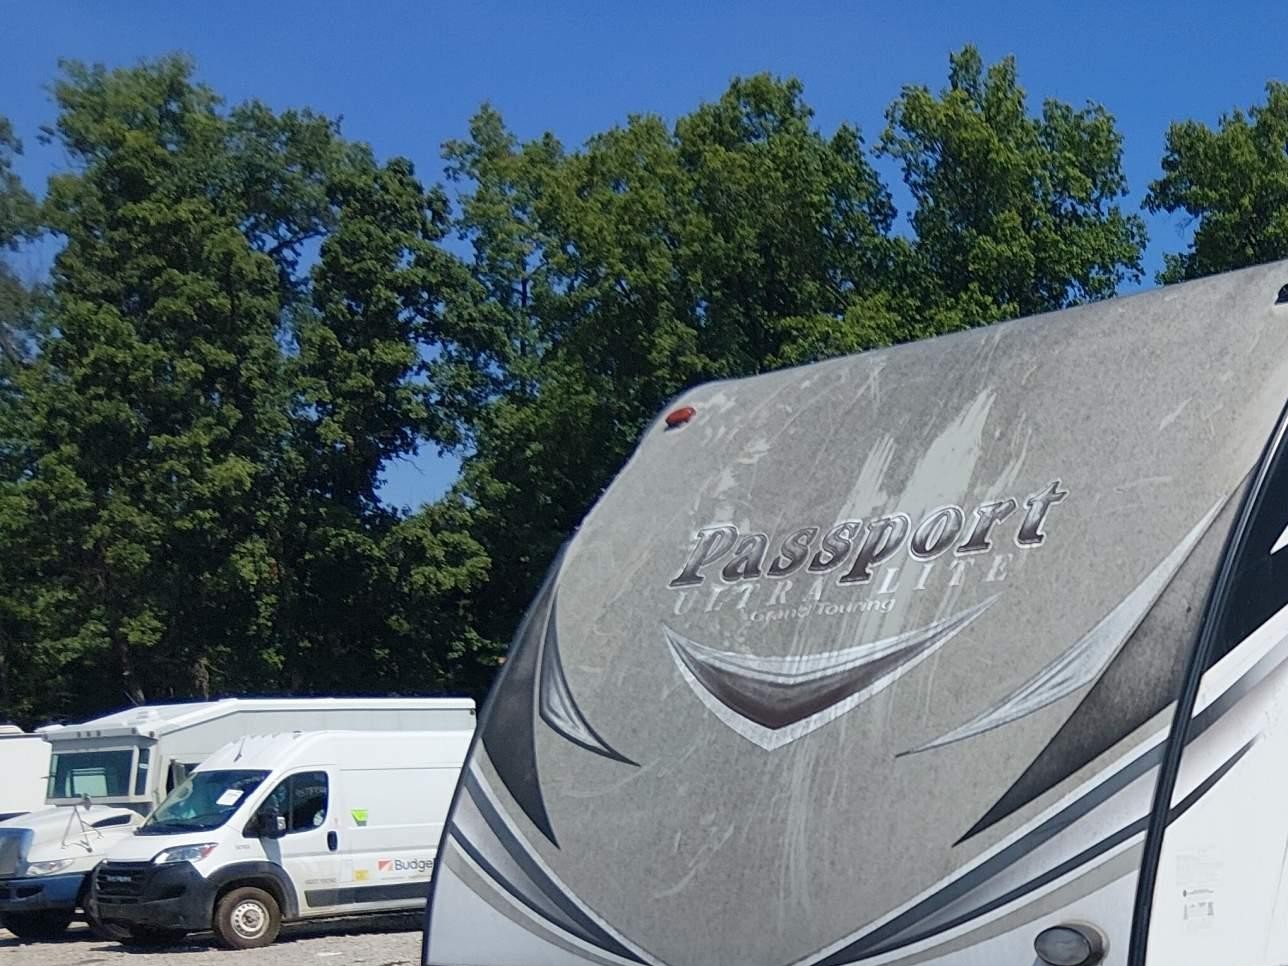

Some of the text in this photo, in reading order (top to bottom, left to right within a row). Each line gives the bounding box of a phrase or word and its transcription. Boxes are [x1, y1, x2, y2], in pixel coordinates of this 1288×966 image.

[668, 479, 1069, 588] Passport
[673, 554, 1013, 615] ULTRA LITE
[395, 859, 433, 872] Budge
